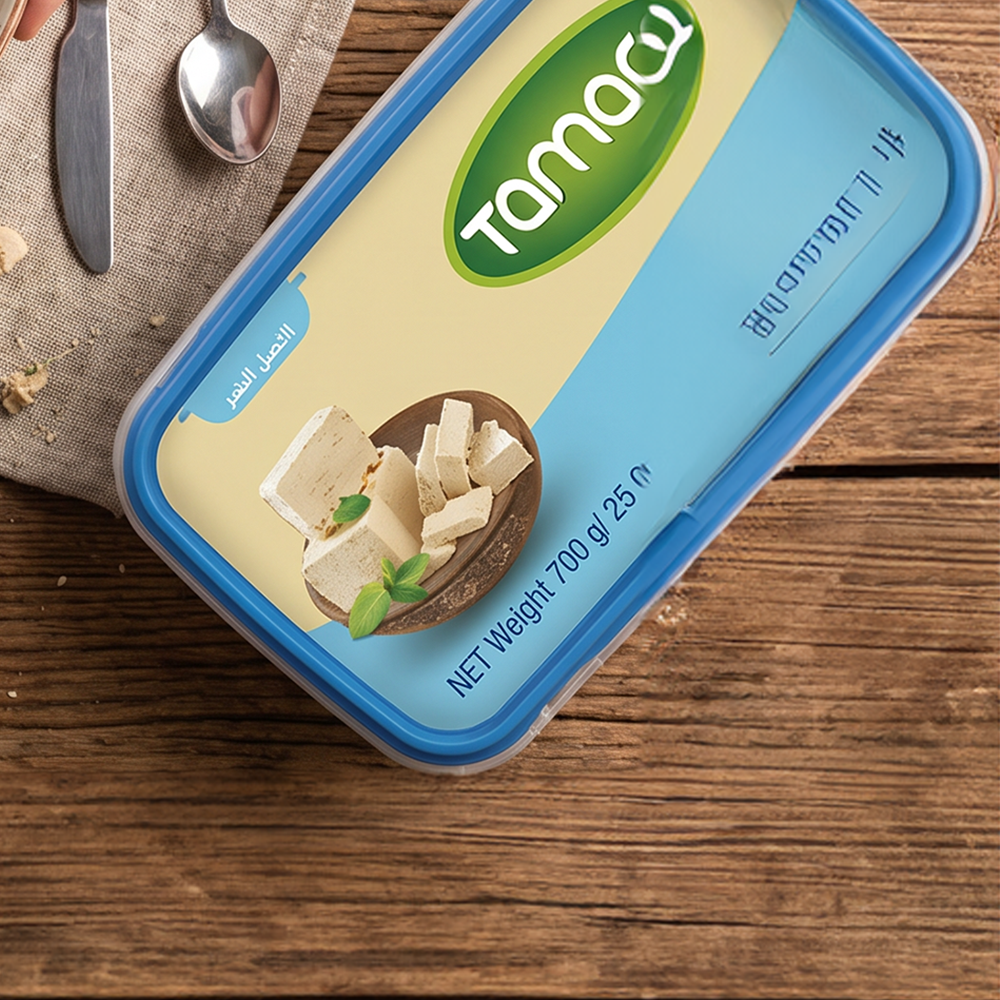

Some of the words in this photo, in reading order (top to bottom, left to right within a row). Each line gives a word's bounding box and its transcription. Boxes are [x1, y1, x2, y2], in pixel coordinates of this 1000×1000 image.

[446, 645, 492, 698] NET
[483, 579, 556, 654] Weight
[545, 538, 590, 585] 700
[602, 483, 637, 522] 25
